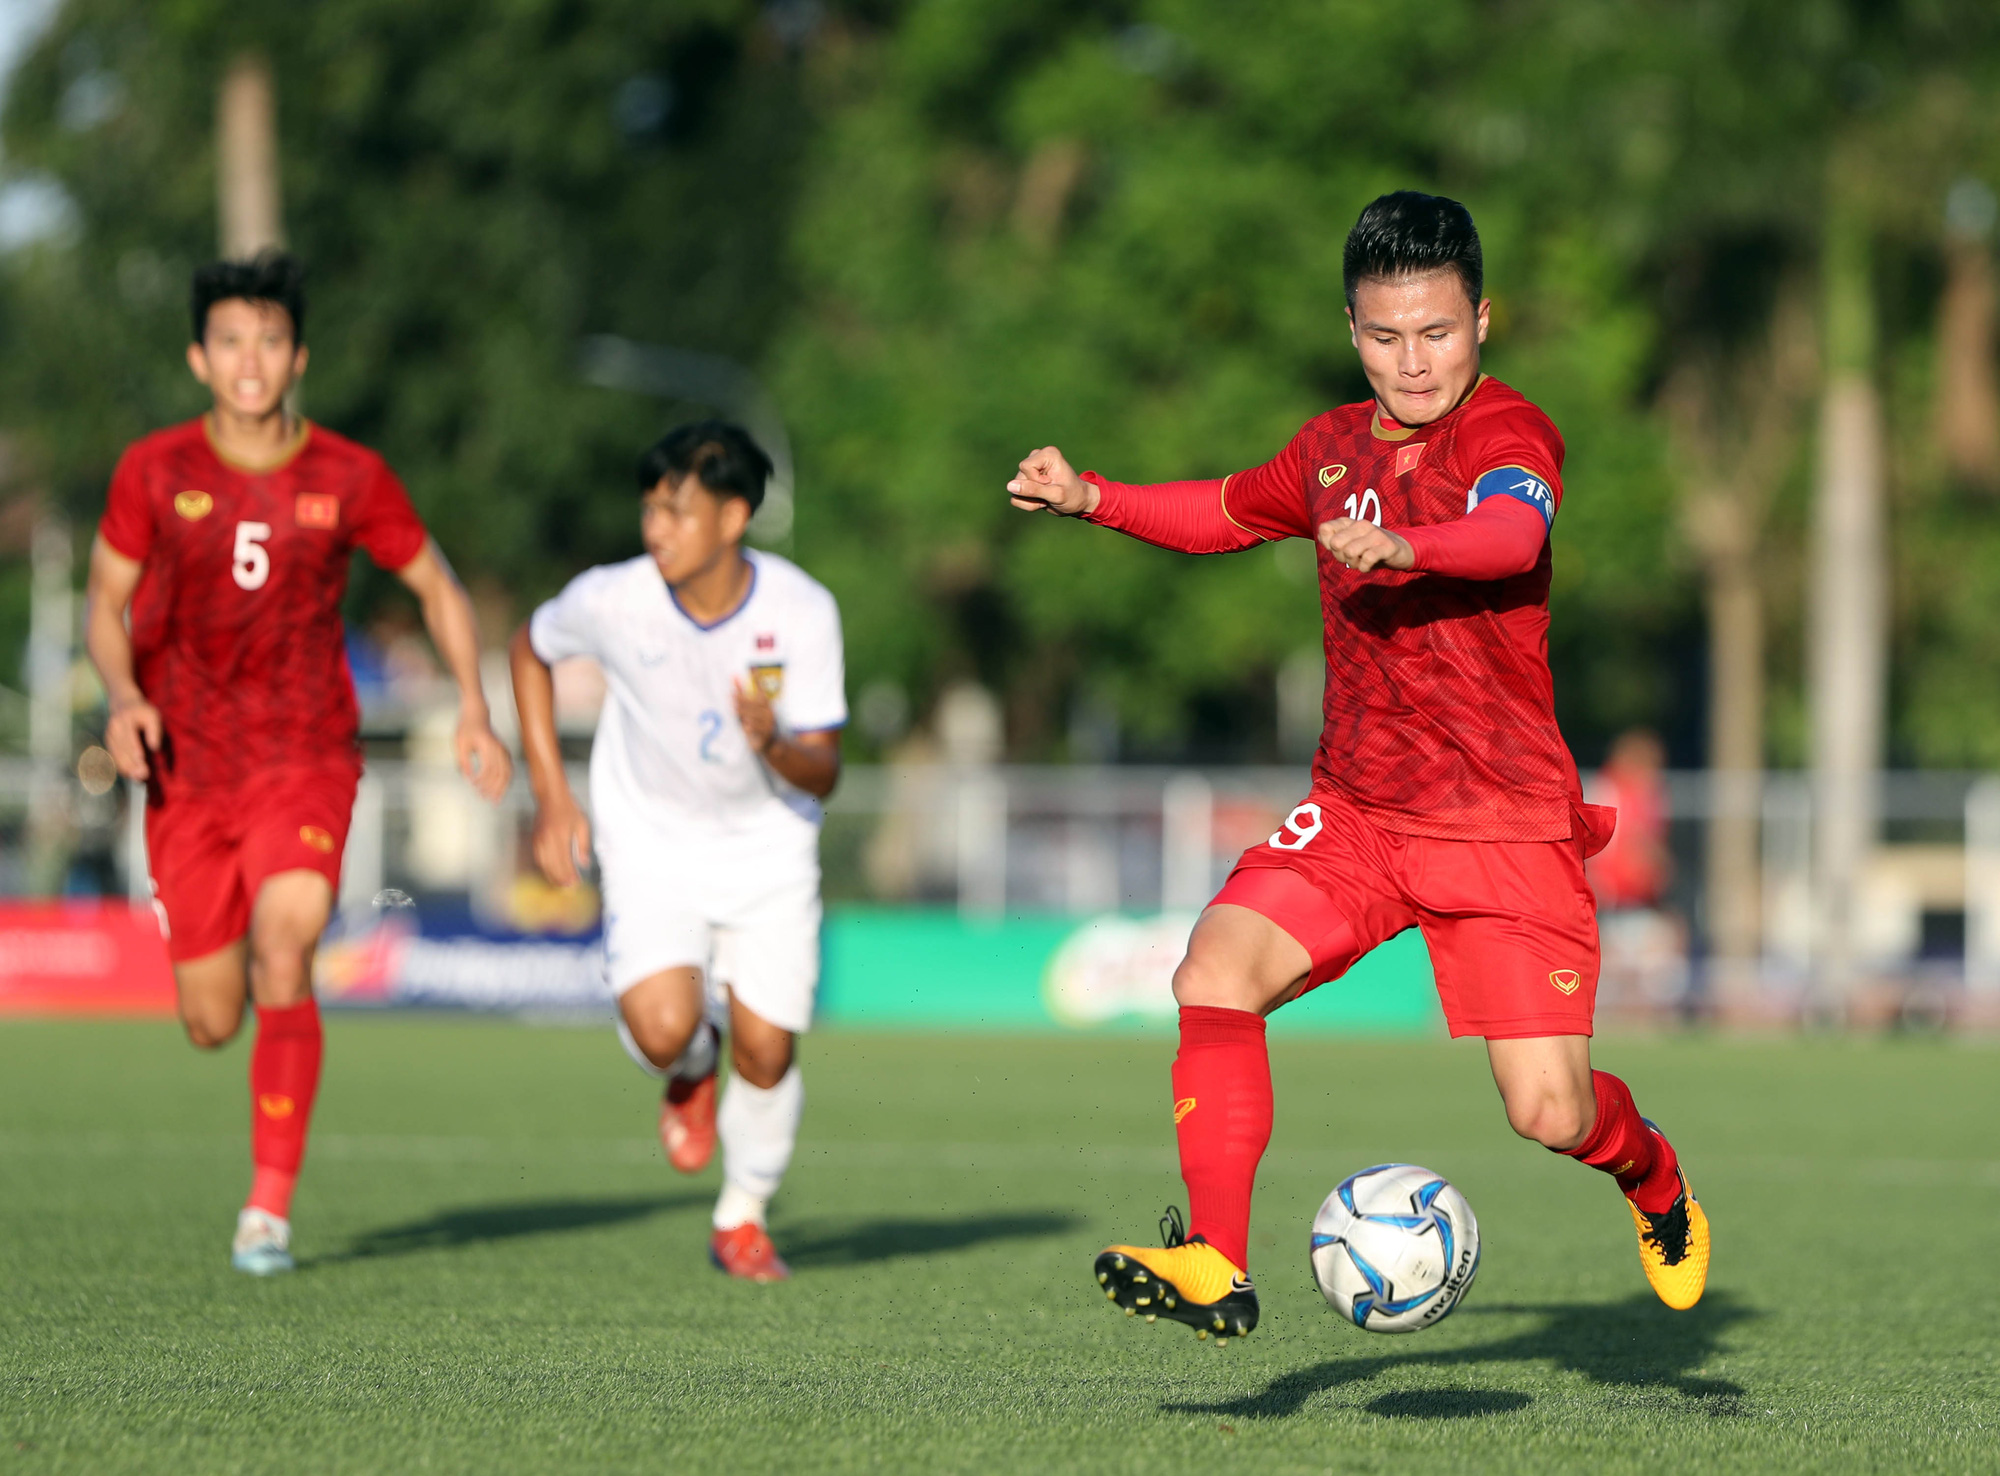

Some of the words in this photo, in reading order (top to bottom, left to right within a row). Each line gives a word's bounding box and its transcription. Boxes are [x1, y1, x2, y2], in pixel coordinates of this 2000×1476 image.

[1344, 488, 1382, 527] 10
[232, 520, 272, 591] 5
[698, 706, 725, 765] 2
[1423, 1249, 1471, 1319] molten
